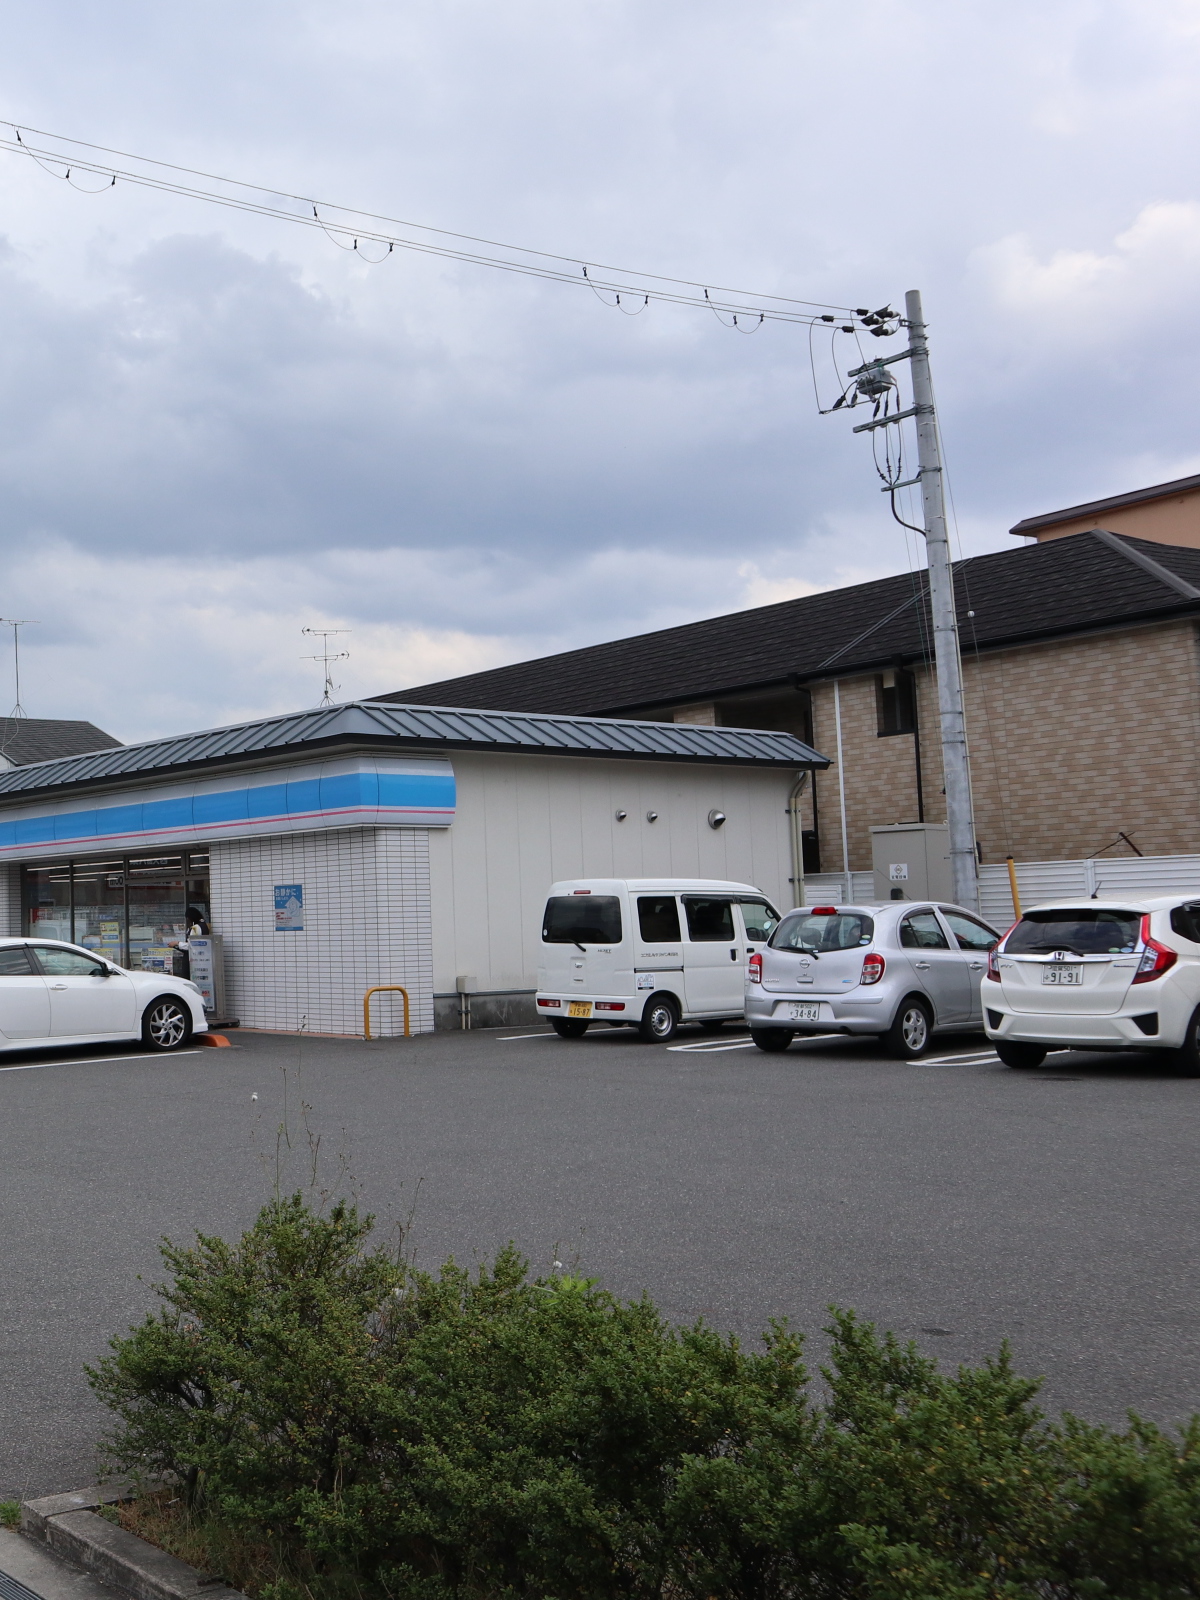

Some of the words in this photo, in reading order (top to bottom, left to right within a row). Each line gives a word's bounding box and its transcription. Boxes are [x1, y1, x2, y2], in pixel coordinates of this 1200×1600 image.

[1050, 972, 1079, 983] 91-91
[573, 1007, 590, 1016] 15-87
[794, 1009, 817, 1018] 34-84
